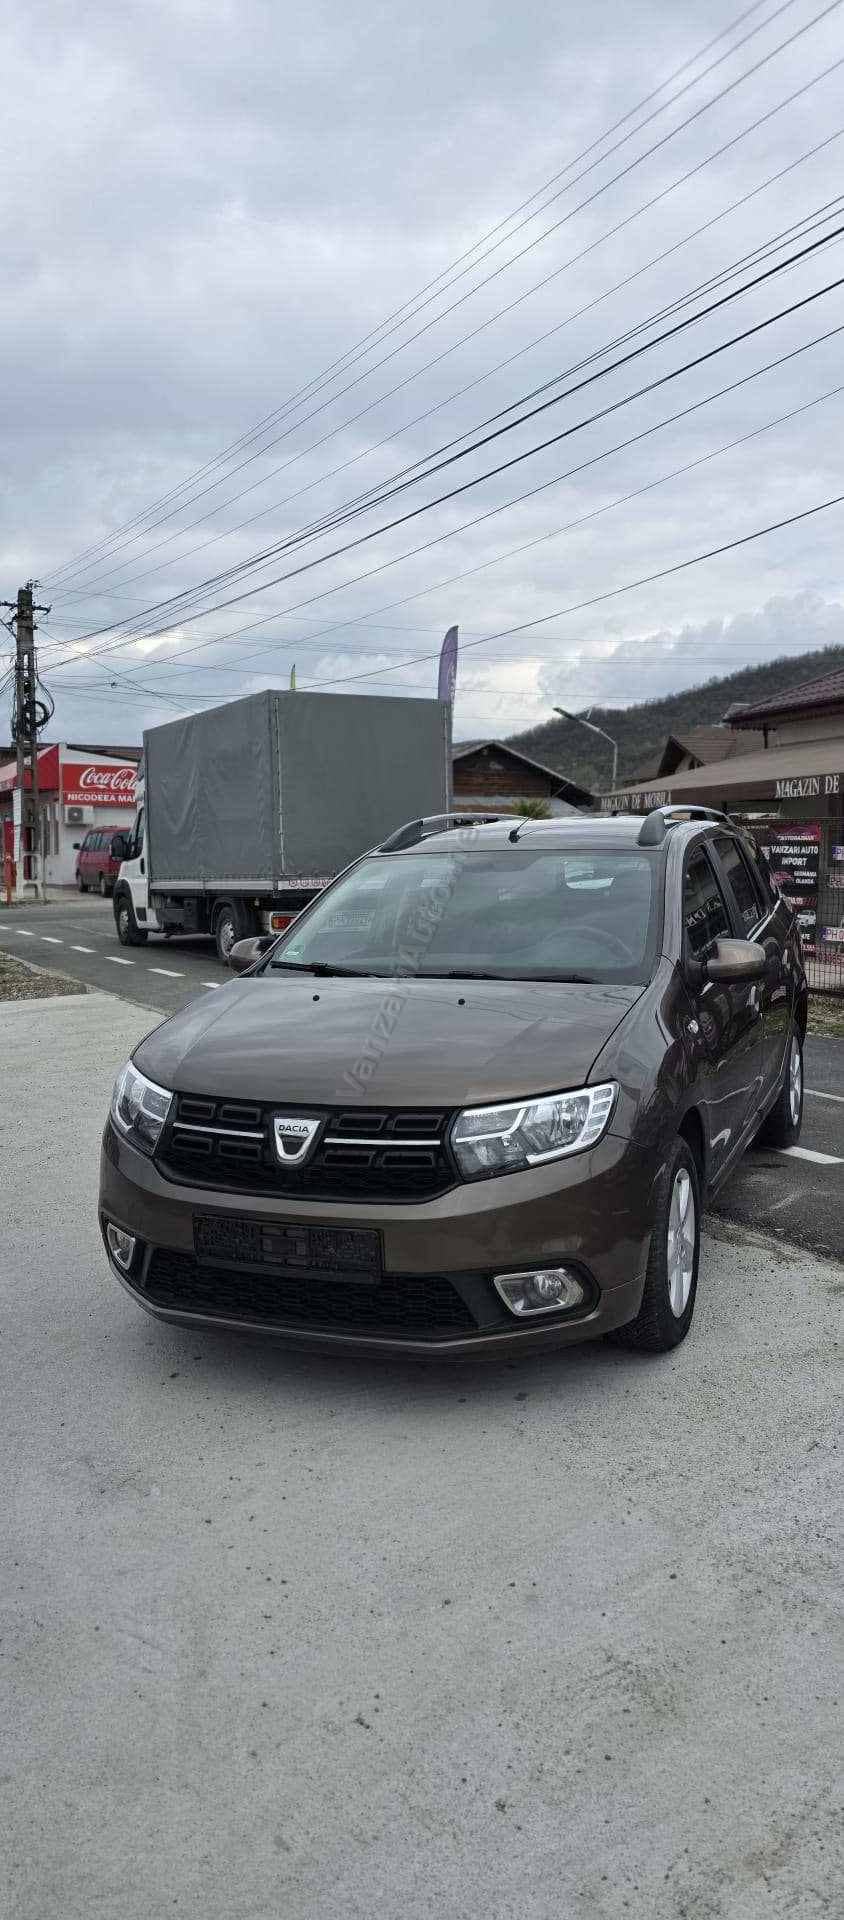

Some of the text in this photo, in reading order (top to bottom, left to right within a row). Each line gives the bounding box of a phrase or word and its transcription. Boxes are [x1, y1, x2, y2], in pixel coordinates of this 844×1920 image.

[774, 774, 840, 798] MAGAZIN DE
[601, 797, 629, 810] MAGAZIN
[631, 796, 642, 809] DE
[801, 845, 819, 854] AUTO
[279, 1124, 309, 1134] DACIA
